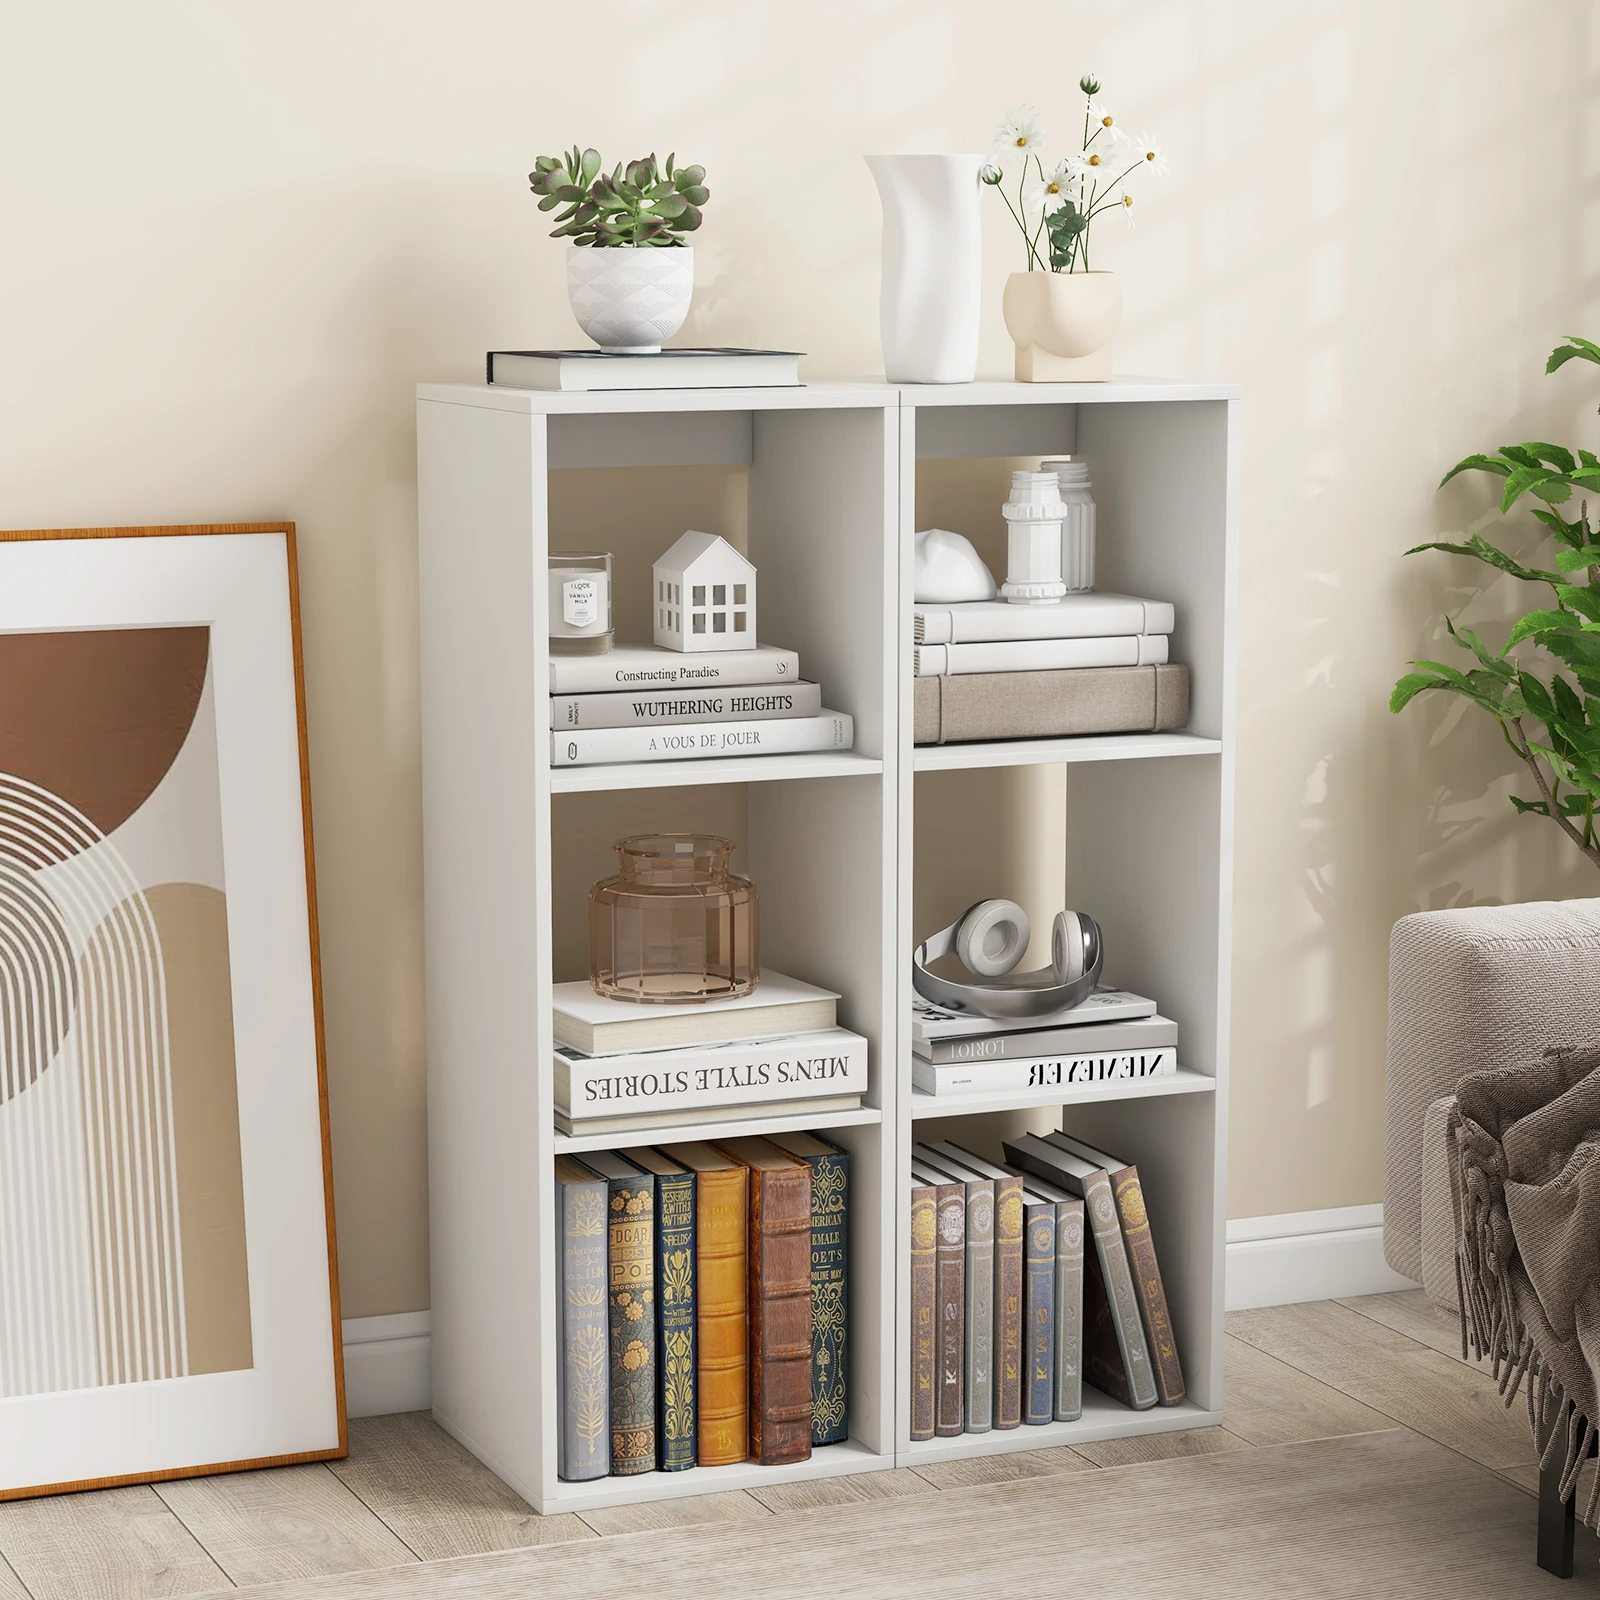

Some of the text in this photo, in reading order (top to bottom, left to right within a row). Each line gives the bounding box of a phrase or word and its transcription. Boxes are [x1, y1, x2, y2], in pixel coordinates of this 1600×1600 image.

[615, 667, 720, 682] Constructing Paradies
[632, 695, 793, 718] WUTHERING HEIGHTS
[648, 731, 762, 751] A VOUS DE JOUER
[947, 1038, 1005, 1059] LORIOT
[585, 1055, 851, 1101] MEN'S STYLE STORIES
[811, 1213, 842, 1227] ERICAN
[667, 1233, 689, 1247] FIELDS
[811, 1231, 840, 1245] EMALE
[811, 1249, 843, 1263] OETS
[612, 1263, 652, 1281] POE
[830, 1269, 842, 1279] MAY
